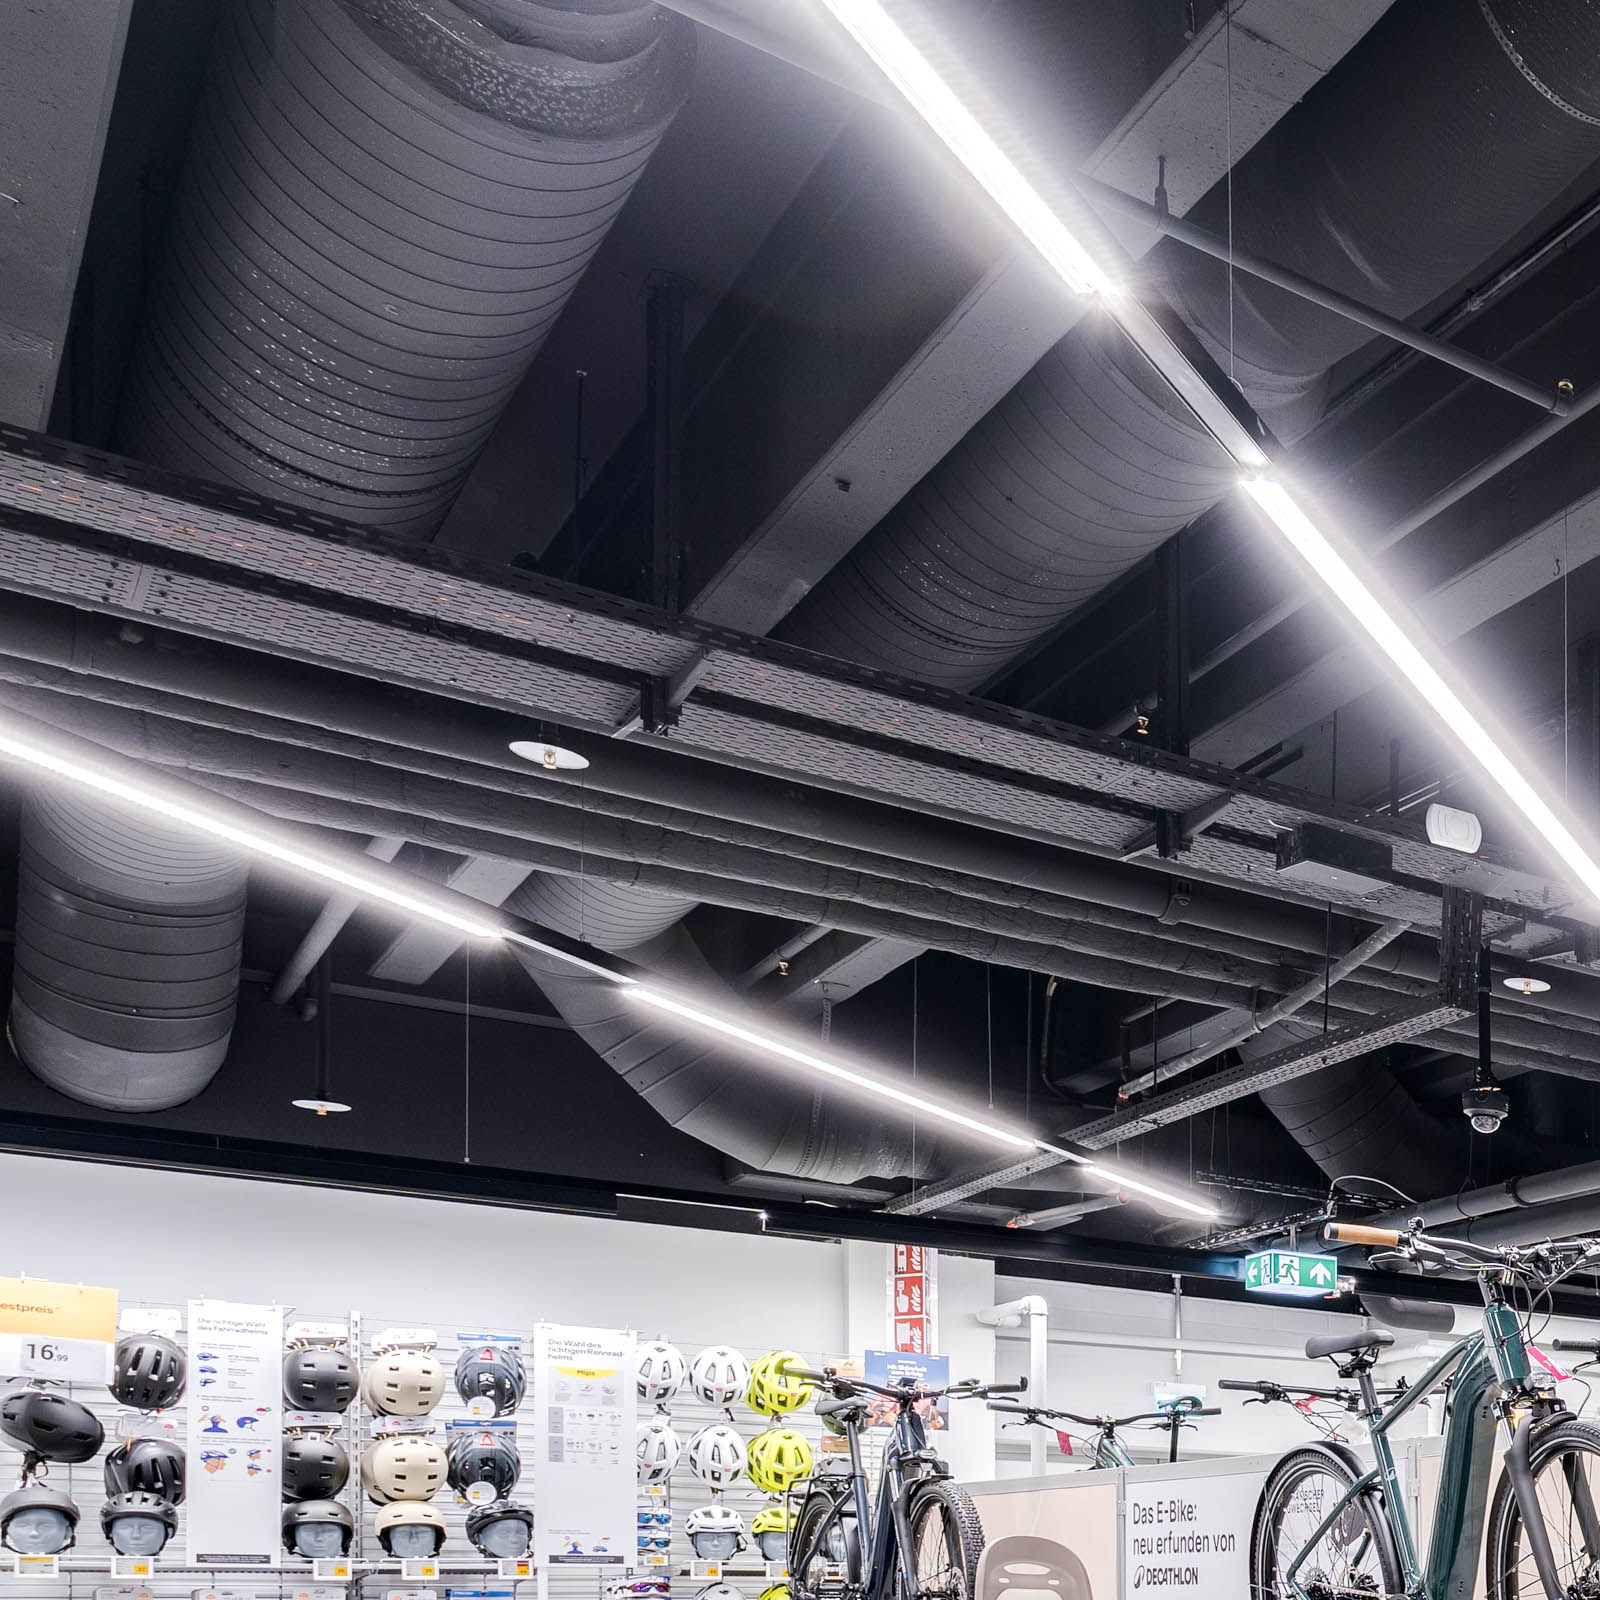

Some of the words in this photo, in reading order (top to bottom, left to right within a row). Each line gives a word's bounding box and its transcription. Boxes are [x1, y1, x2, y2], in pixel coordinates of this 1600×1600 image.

[0, 1303, 53, 1314] estpreis
[1133, 1502, 1154, 1525] Das
[1157, 1500, 1198, 1523] E-Bike:
[1133, 1536, 1154, 1555] neu
[1156, 1529, 1210, 1554] erfunden
[1213, 1533, 1236, 1553] von
[1146, 1567, 1199, 1585] DECATHLON
